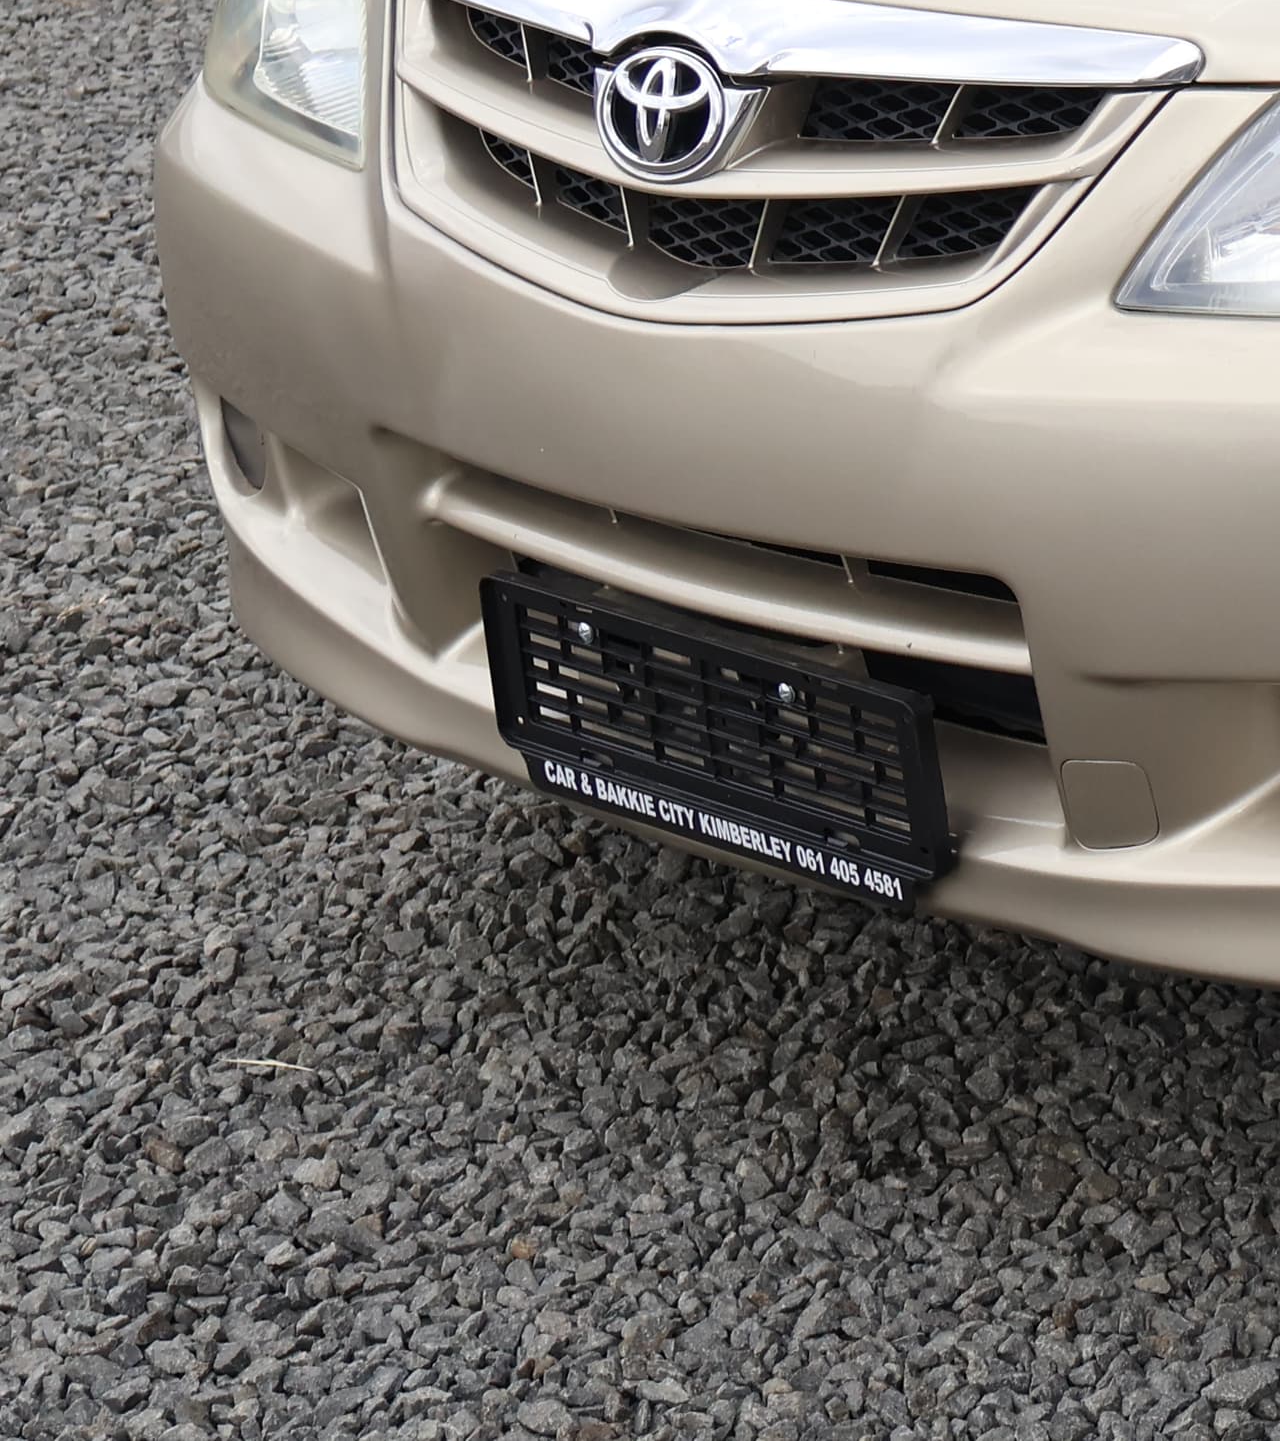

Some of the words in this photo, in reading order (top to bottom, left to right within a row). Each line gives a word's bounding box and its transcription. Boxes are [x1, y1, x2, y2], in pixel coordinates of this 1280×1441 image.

[544, 760, 578, 791] CAR
[580, 773, 593, 796] &
[595, 777, 657, 817] BAKKIE
[658, 799, 694, 830] CITY
[699, 812, 791, 862] KIMBERLEY
[796, 845, 825, 875] 061
[830, 857, 860, 886] 405
[863, 868, 903, 900] 4581
